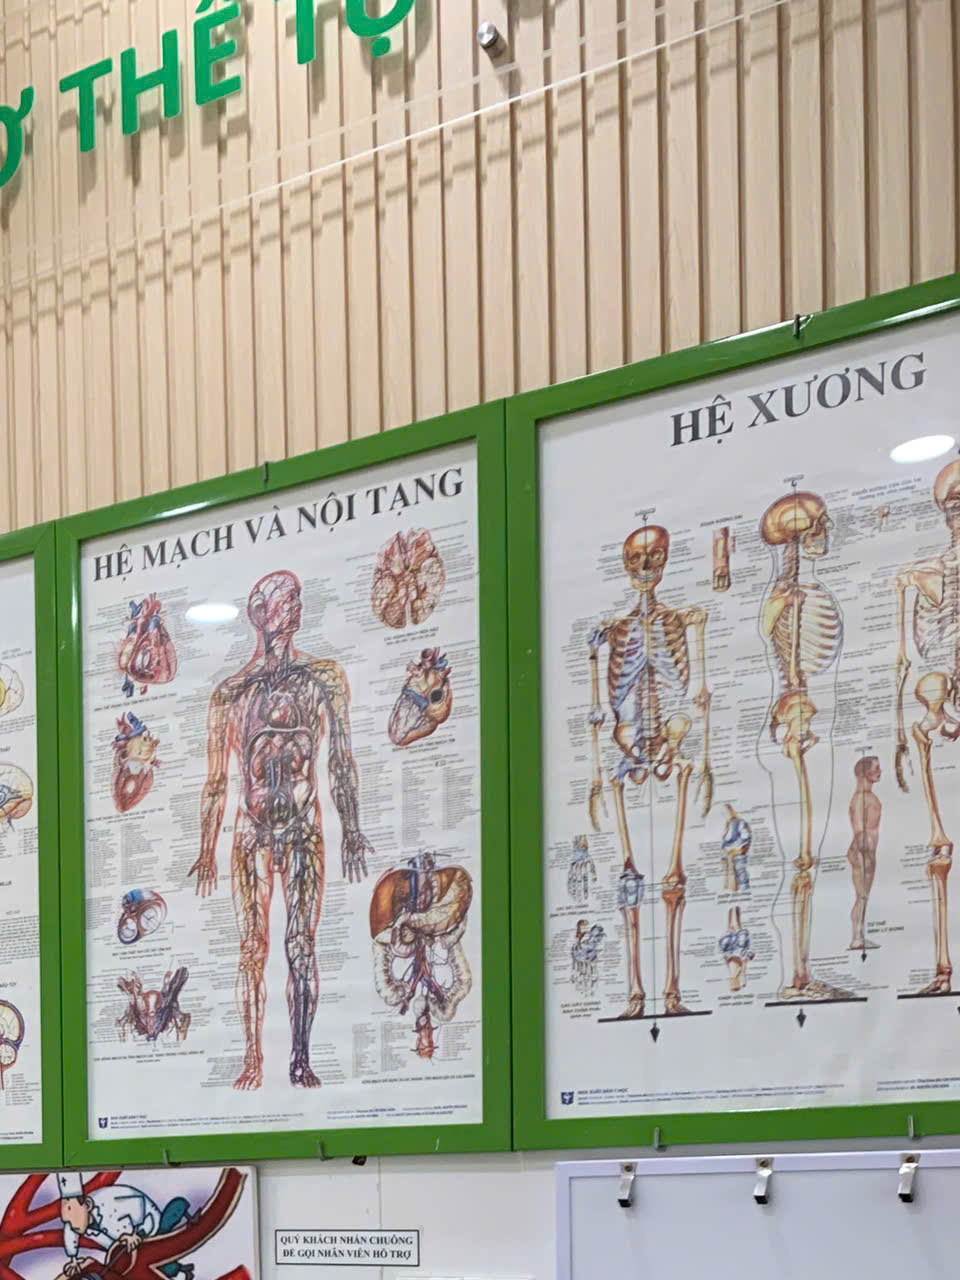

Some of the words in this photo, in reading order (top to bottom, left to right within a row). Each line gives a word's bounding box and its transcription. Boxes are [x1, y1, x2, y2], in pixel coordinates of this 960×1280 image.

[669, 394, 734, 447] HỆ
[747, 352, 928, 428] XƯƠNG
[93, 544, 133, 582] HỆ
[141, 524, 235, 570] MẠCH
[245, 505, 288, 545] VÀ
[296, 491, 357, 533] NỘI
[366, 467, 464, 517] TẠNG
[297, 1249, 315, 1259] GỌI
[347, 1248, 370, 1259] VIÊN
[303, 1234, 337, 1245] KHÁCH
[369, 1234, 414, 1246] CHUÔNG
